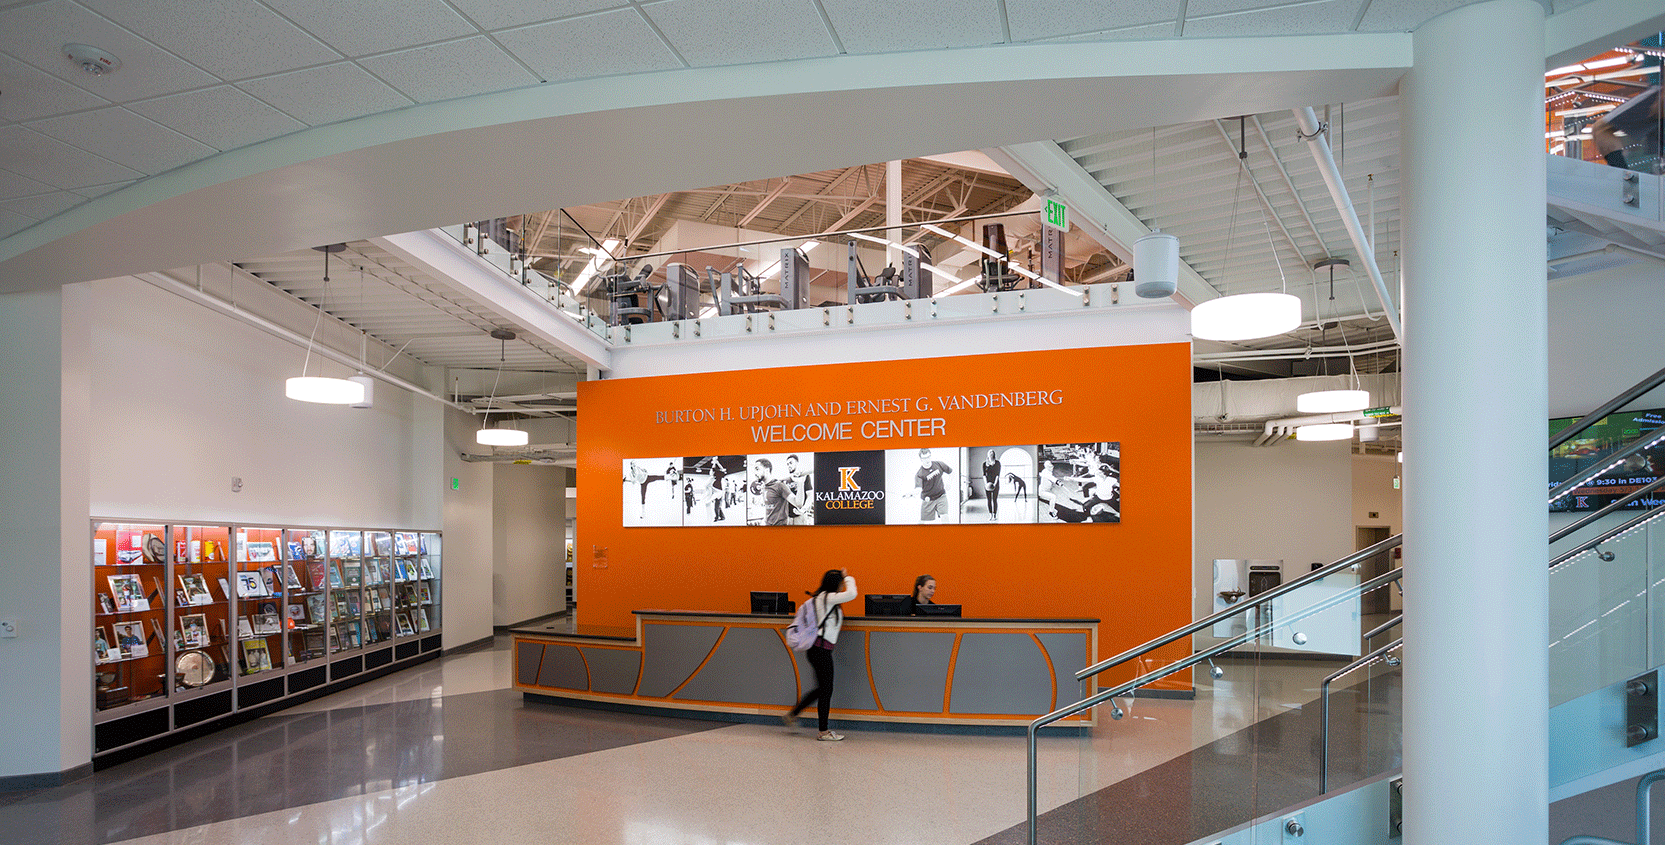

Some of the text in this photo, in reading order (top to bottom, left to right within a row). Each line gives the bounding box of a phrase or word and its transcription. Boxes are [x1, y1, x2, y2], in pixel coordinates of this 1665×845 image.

[1047, 199, 1066, 228] EXIT
[655, 389, 1064, 424] BURTON H. UPJOHN AND ERNEST G. VANDENBERG
[751, 417, 947, 443] WELCOME CENTER
[838, 466, 862, 491] K
[1596, 478, 1617, 486] 9:30
[815, 490, 885, 501] KALAMAZOO
[1575, 496, 1590, 508] K
[825, 500, 875, 510] COLLEGE
